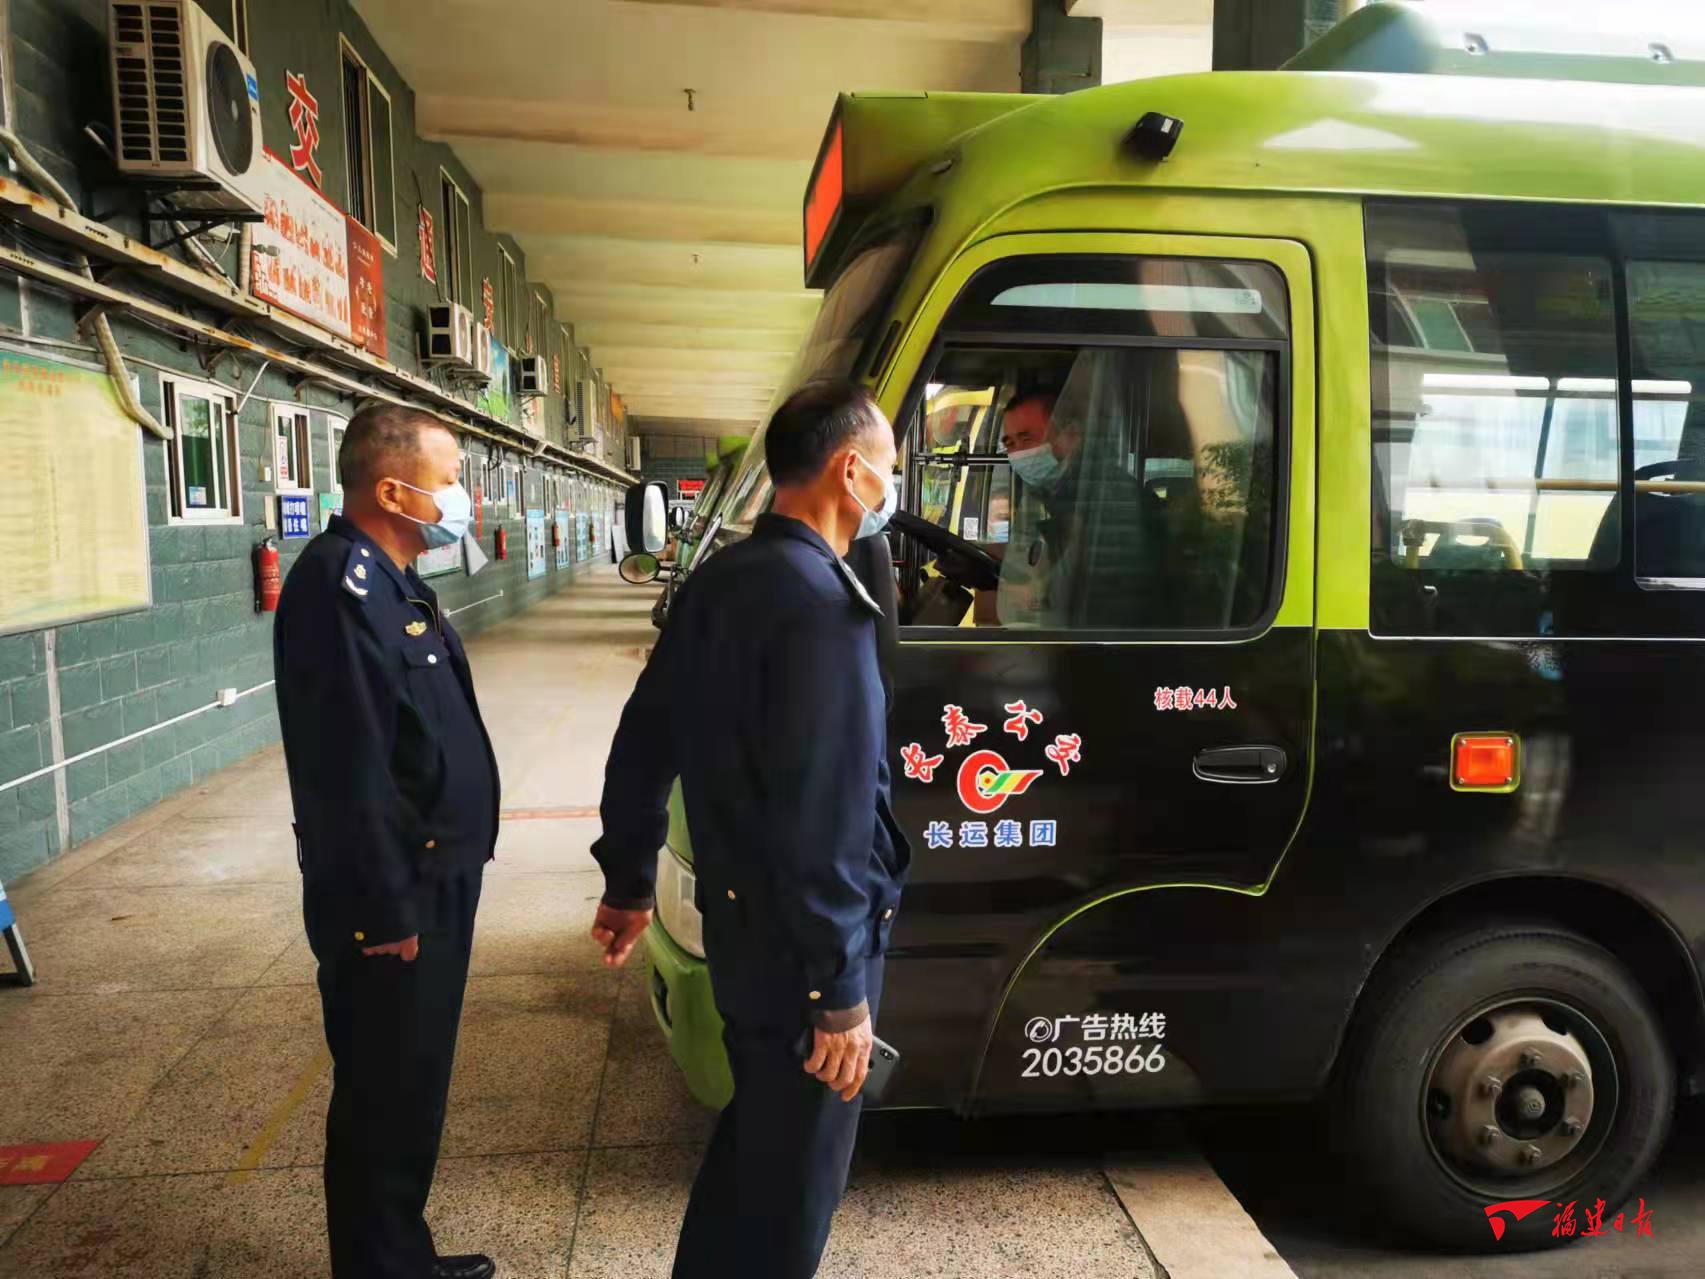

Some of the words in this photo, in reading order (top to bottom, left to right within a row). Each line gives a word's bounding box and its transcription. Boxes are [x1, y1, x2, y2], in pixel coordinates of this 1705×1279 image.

[1153, 685, 1238, 711] 核载44人
[923, 819, 1057, 850] 长运集团
[1051, 1012, 1167, 1042] 广告热线
[1021, 1043, 1167, 1078] 2035866
